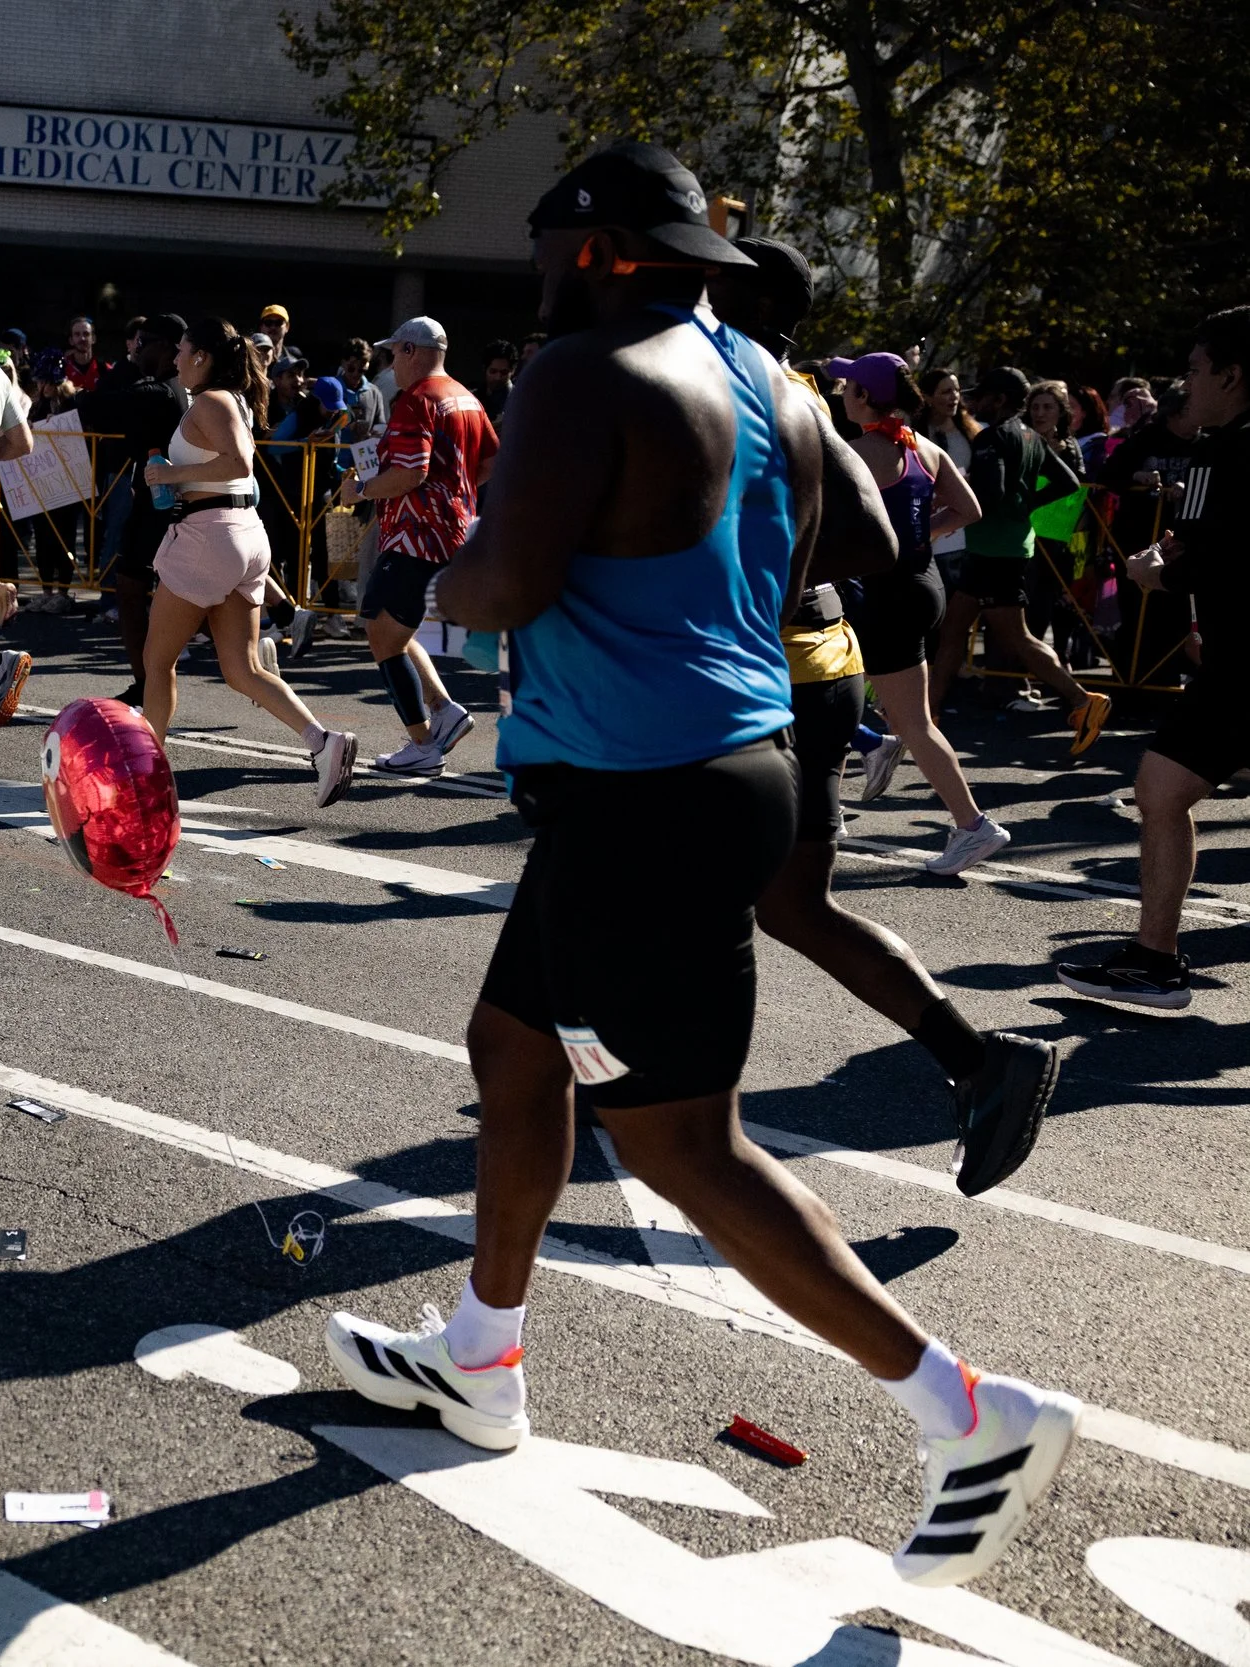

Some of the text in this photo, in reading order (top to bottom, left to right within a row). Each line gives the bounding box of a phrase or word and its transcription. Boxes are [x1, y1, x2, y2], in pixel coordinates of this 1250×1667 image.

[25, 114, 344, 167] BROOKLYN PLAZ
[167, 158, 316, 198] CENTER
